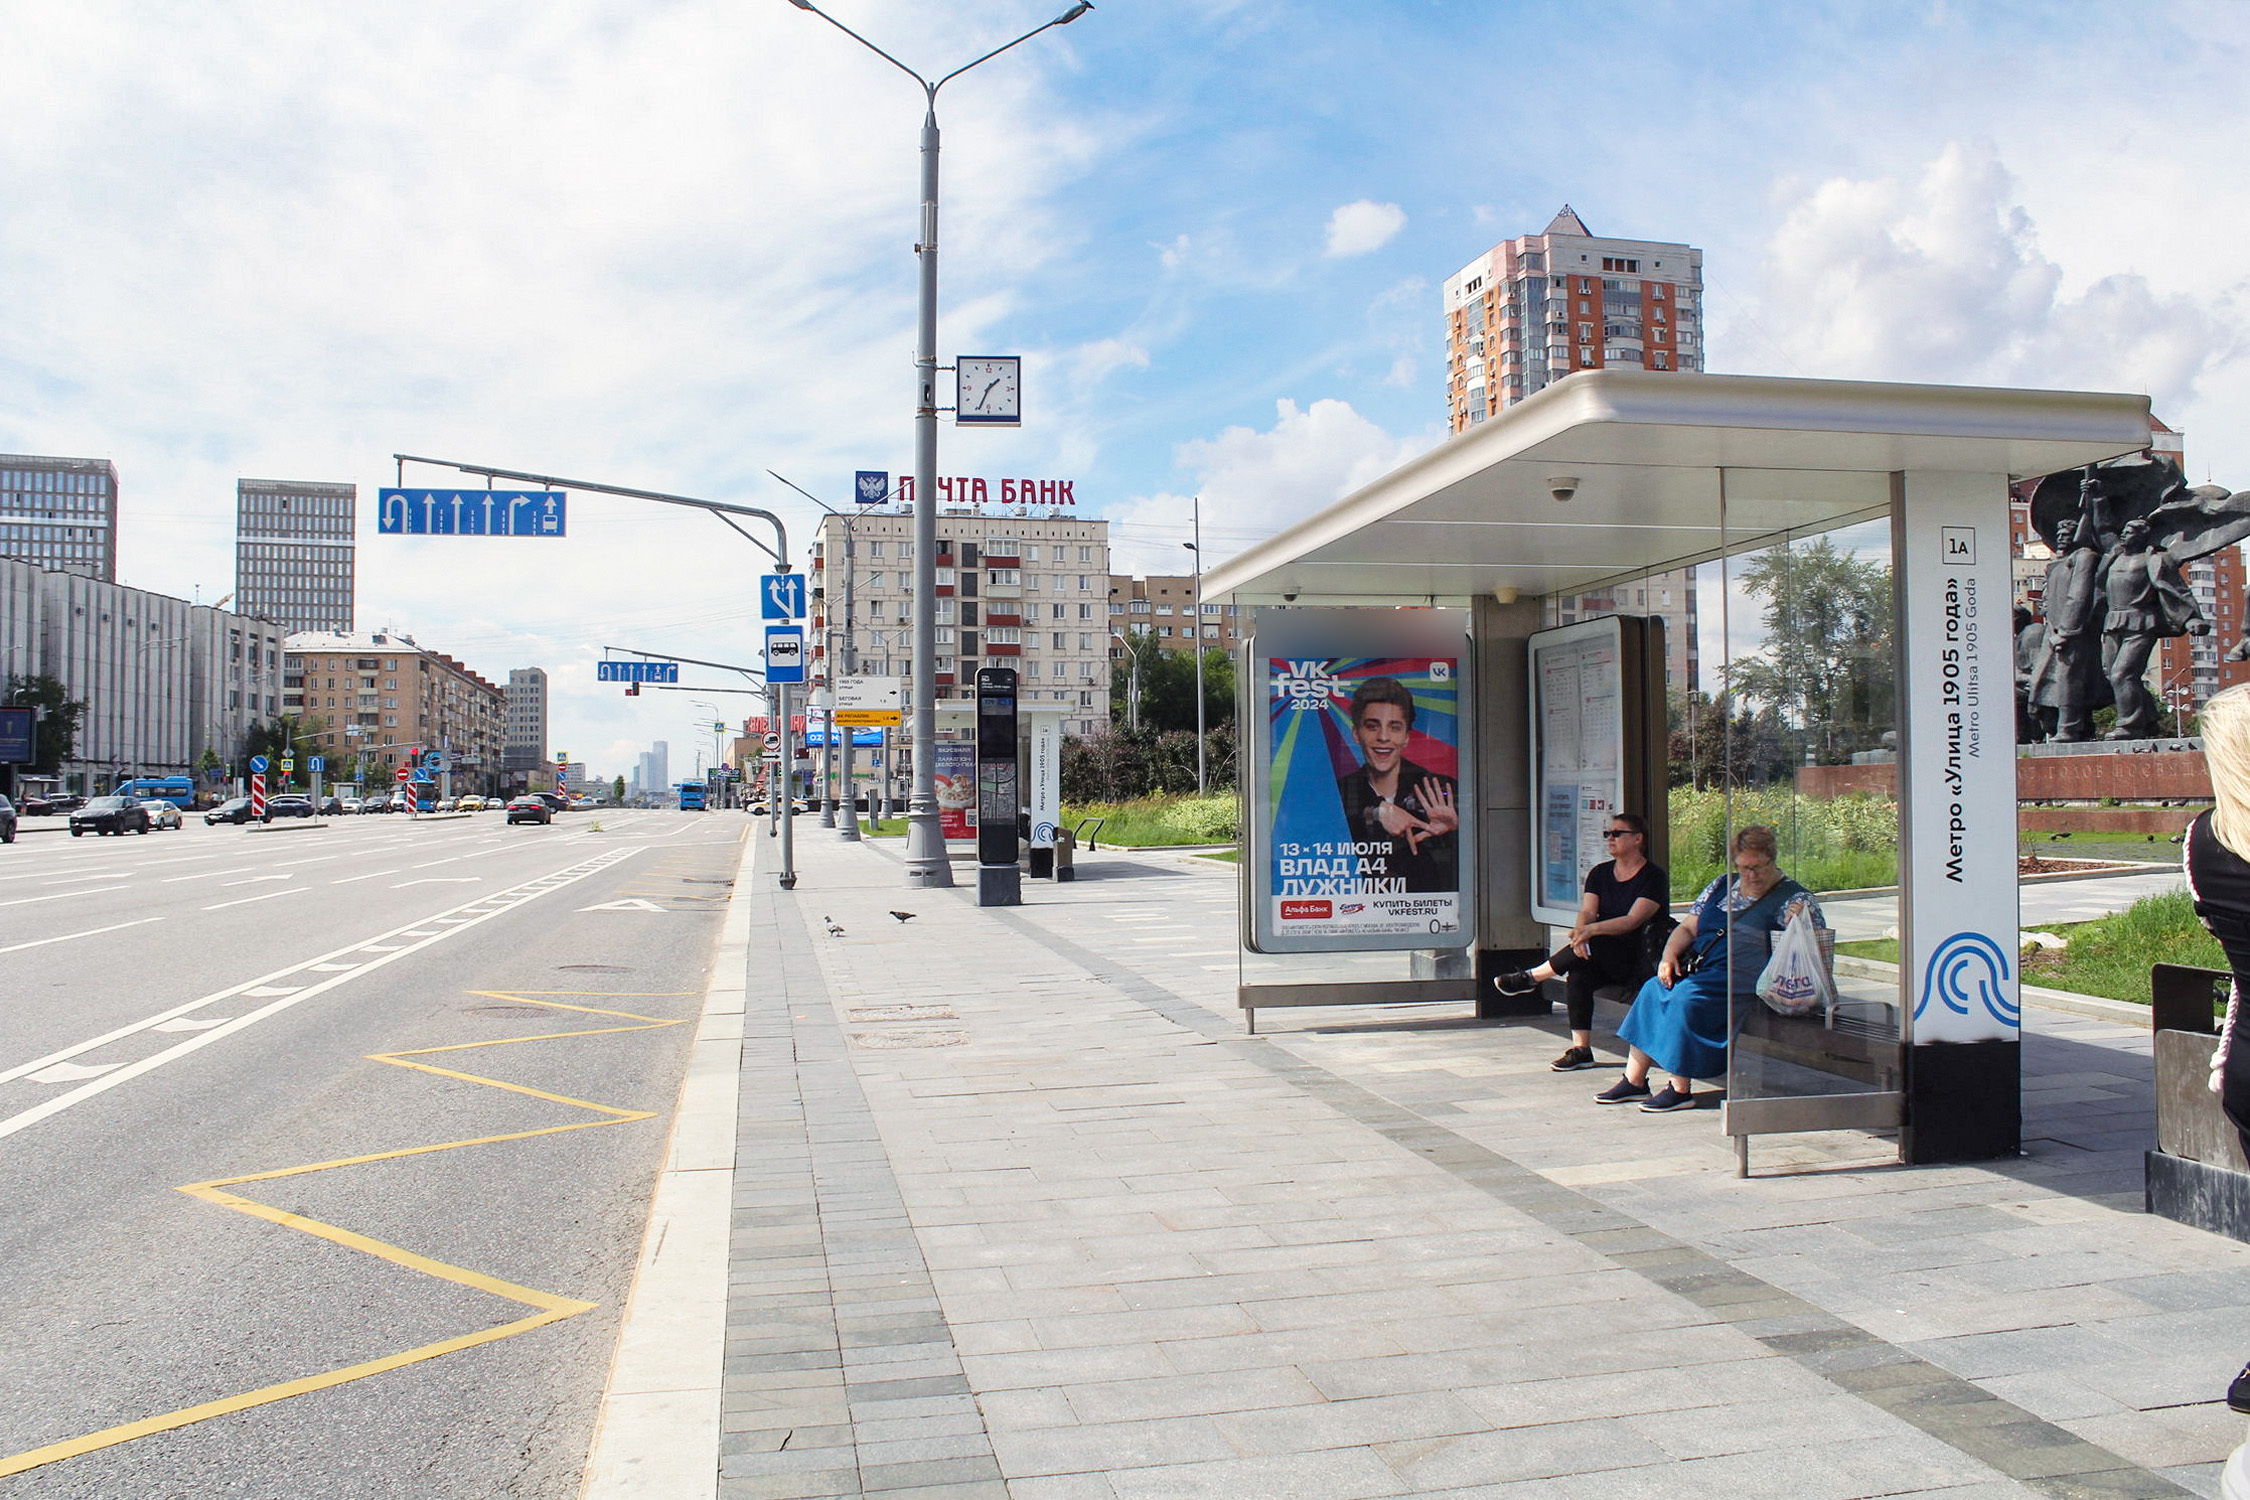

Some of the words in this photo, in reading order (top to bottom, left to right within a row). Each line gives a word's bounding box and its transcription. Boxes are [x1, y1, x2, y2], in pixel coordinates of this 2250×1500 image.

[899, 476, 988, 503] ПЧТА
[1001, 478, 1076, 505] БАНК
[1964, 577, 1977, 618] Goda
[1945, 577, 1961, 642] года»
[1966, 623, 1978, 662] 1905
[1288, 660, 1331, 679] VK
[1432, 666, 1447, 678] VK
[1942, 649, 1960, 706] 1905
[1270, 672, 1351, 698] fest
[1967, 665, 1979, 707] Ulitsa
[1290, 699, 1330, 710] 2024
[809, 734, 839, 742] OZN
[1968, 711, 1980, 758] Metro
[1944, 711, 1963, 796] «Улица
[1279, 842, 1300, 856] 13
[1312, 842, 1333, 856] 14
[1337, 841, 1393, 856] ИЮЛЯ
[1945, 803, 1966, 883] Метро
[1279, 858, 1350, 878] ВЛАД
[1354, 857, 1388, 875] А4
[1280, 877, 1407, 895] ЛУЖНИКИ
[1284, 905, 1309, 915] Альфа
[1309, 905, 1329, 913] Банк
[1373, 900, 1412, 908] КУПИТЬ
[1413, 899, 1453, 907] БИЛЕТЫ
[1388, 907, 1438, 916] VKFEST.RU
[1428, 918, 1456, 935] 0+
